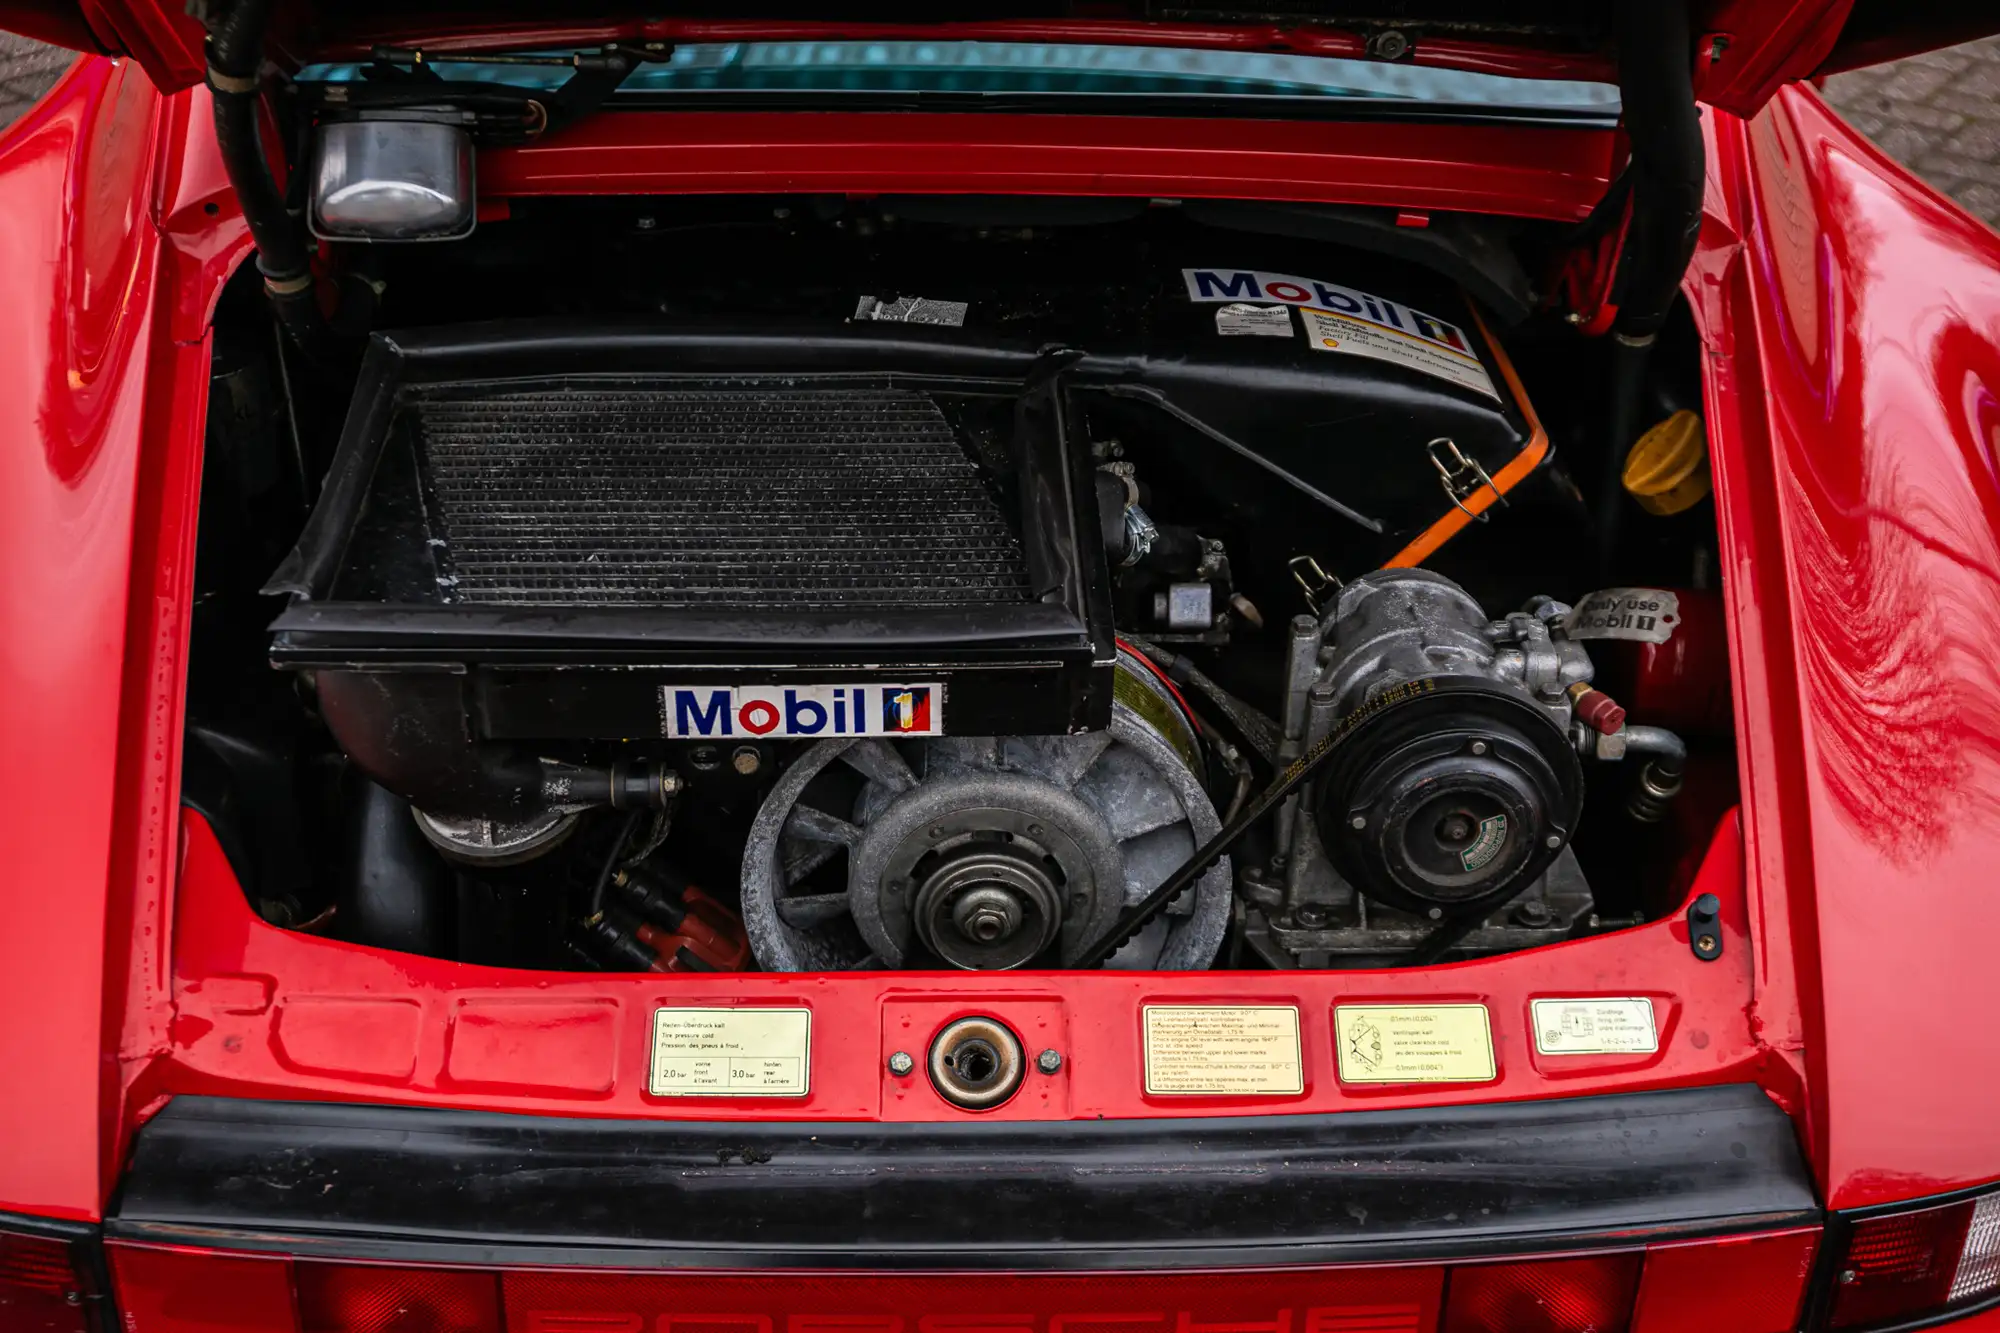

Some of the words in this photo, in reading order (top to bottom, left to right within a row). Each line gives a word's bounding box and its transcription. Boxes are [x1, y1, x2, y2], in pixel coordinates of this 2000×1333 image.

[1194, 271, 1404, 329] Mobil
[1319, 325, 1352, 336] Factory
[1355, 332, 1369, 340] Fill
[1320, 331, 1343, 339] Shell
[1346, 335, 1370, 345] Fuels
[1372, 343, 1389, 351] und
[1391, 348, 1413, 358] Shell
[1626, 600, 1660, 611] use
[675, 689, 866, 735] Mobil
[663, 1069, 676, 1079] 2,0
[732, 1069, 745, 1079] 3,0
